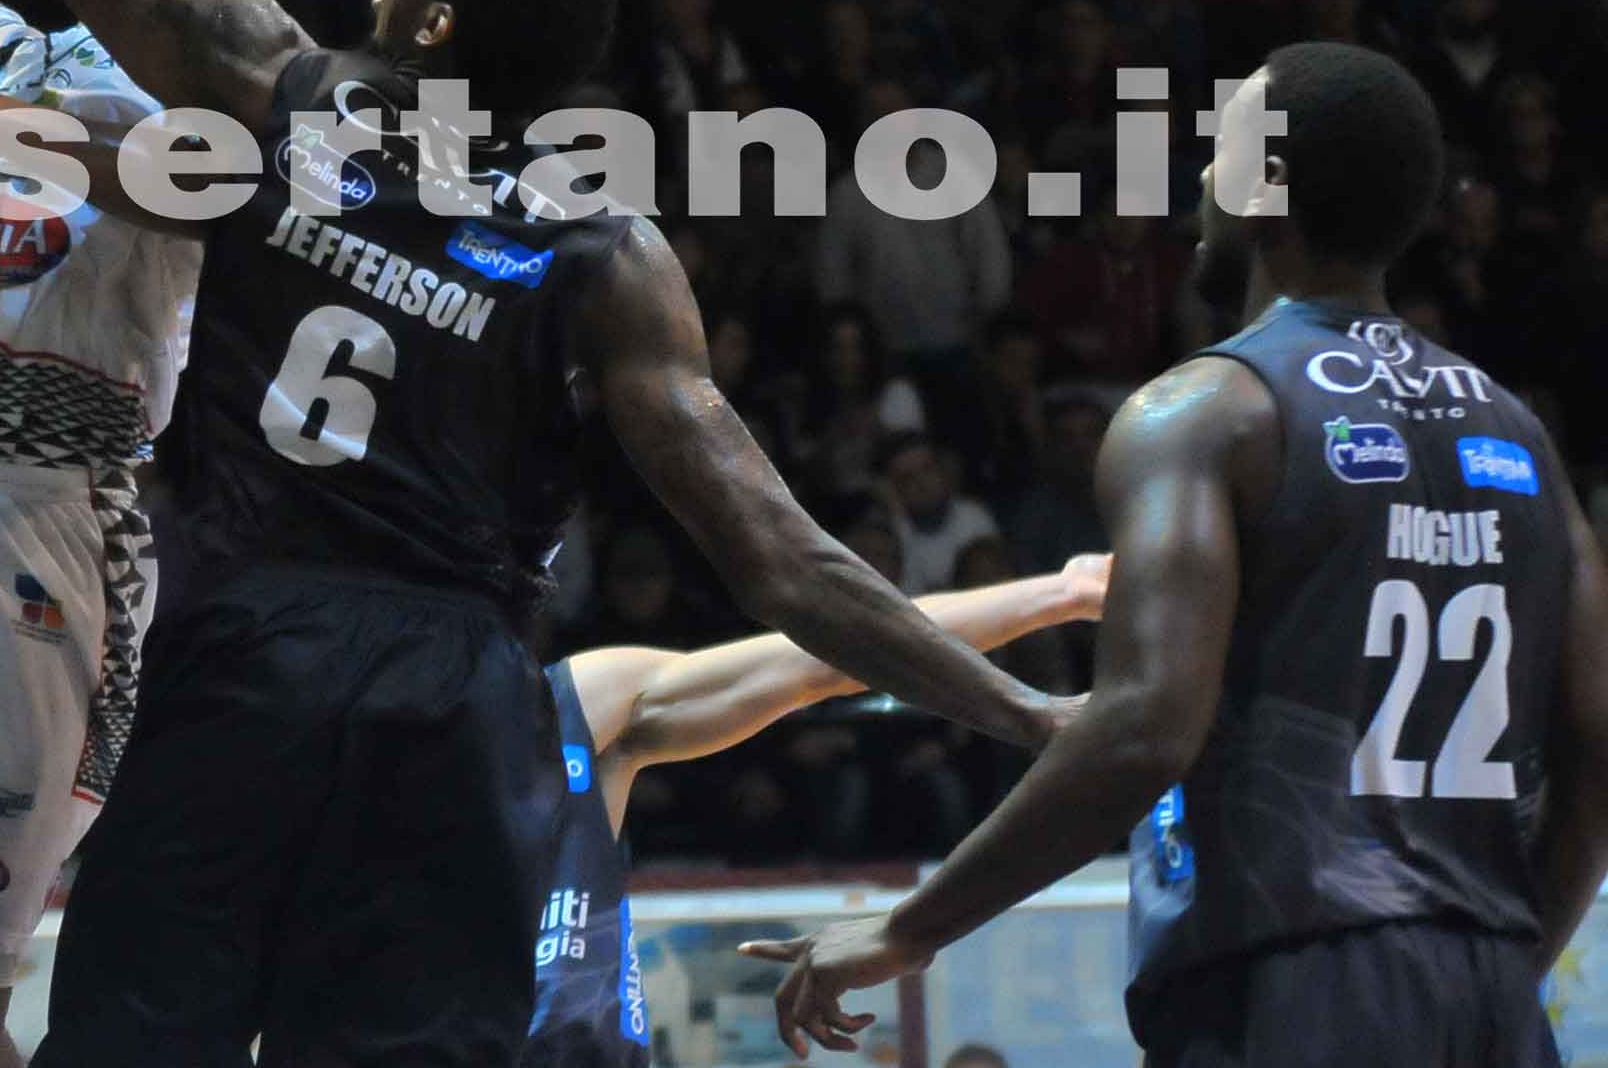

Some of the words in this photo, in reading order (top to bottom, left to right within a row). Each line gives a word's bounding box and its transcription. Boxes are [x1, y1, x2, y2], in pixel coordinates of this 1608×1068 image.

[284, 144, 367, 200] Melinda
[265, 205, 497, 343] JEFFERSON
[259, 305, 396, 466] 6
[1387, 502, 1503, 567] HOGUE
[1350, 579, 1517, 799] 22
[540, 889, 590, 930] iti
